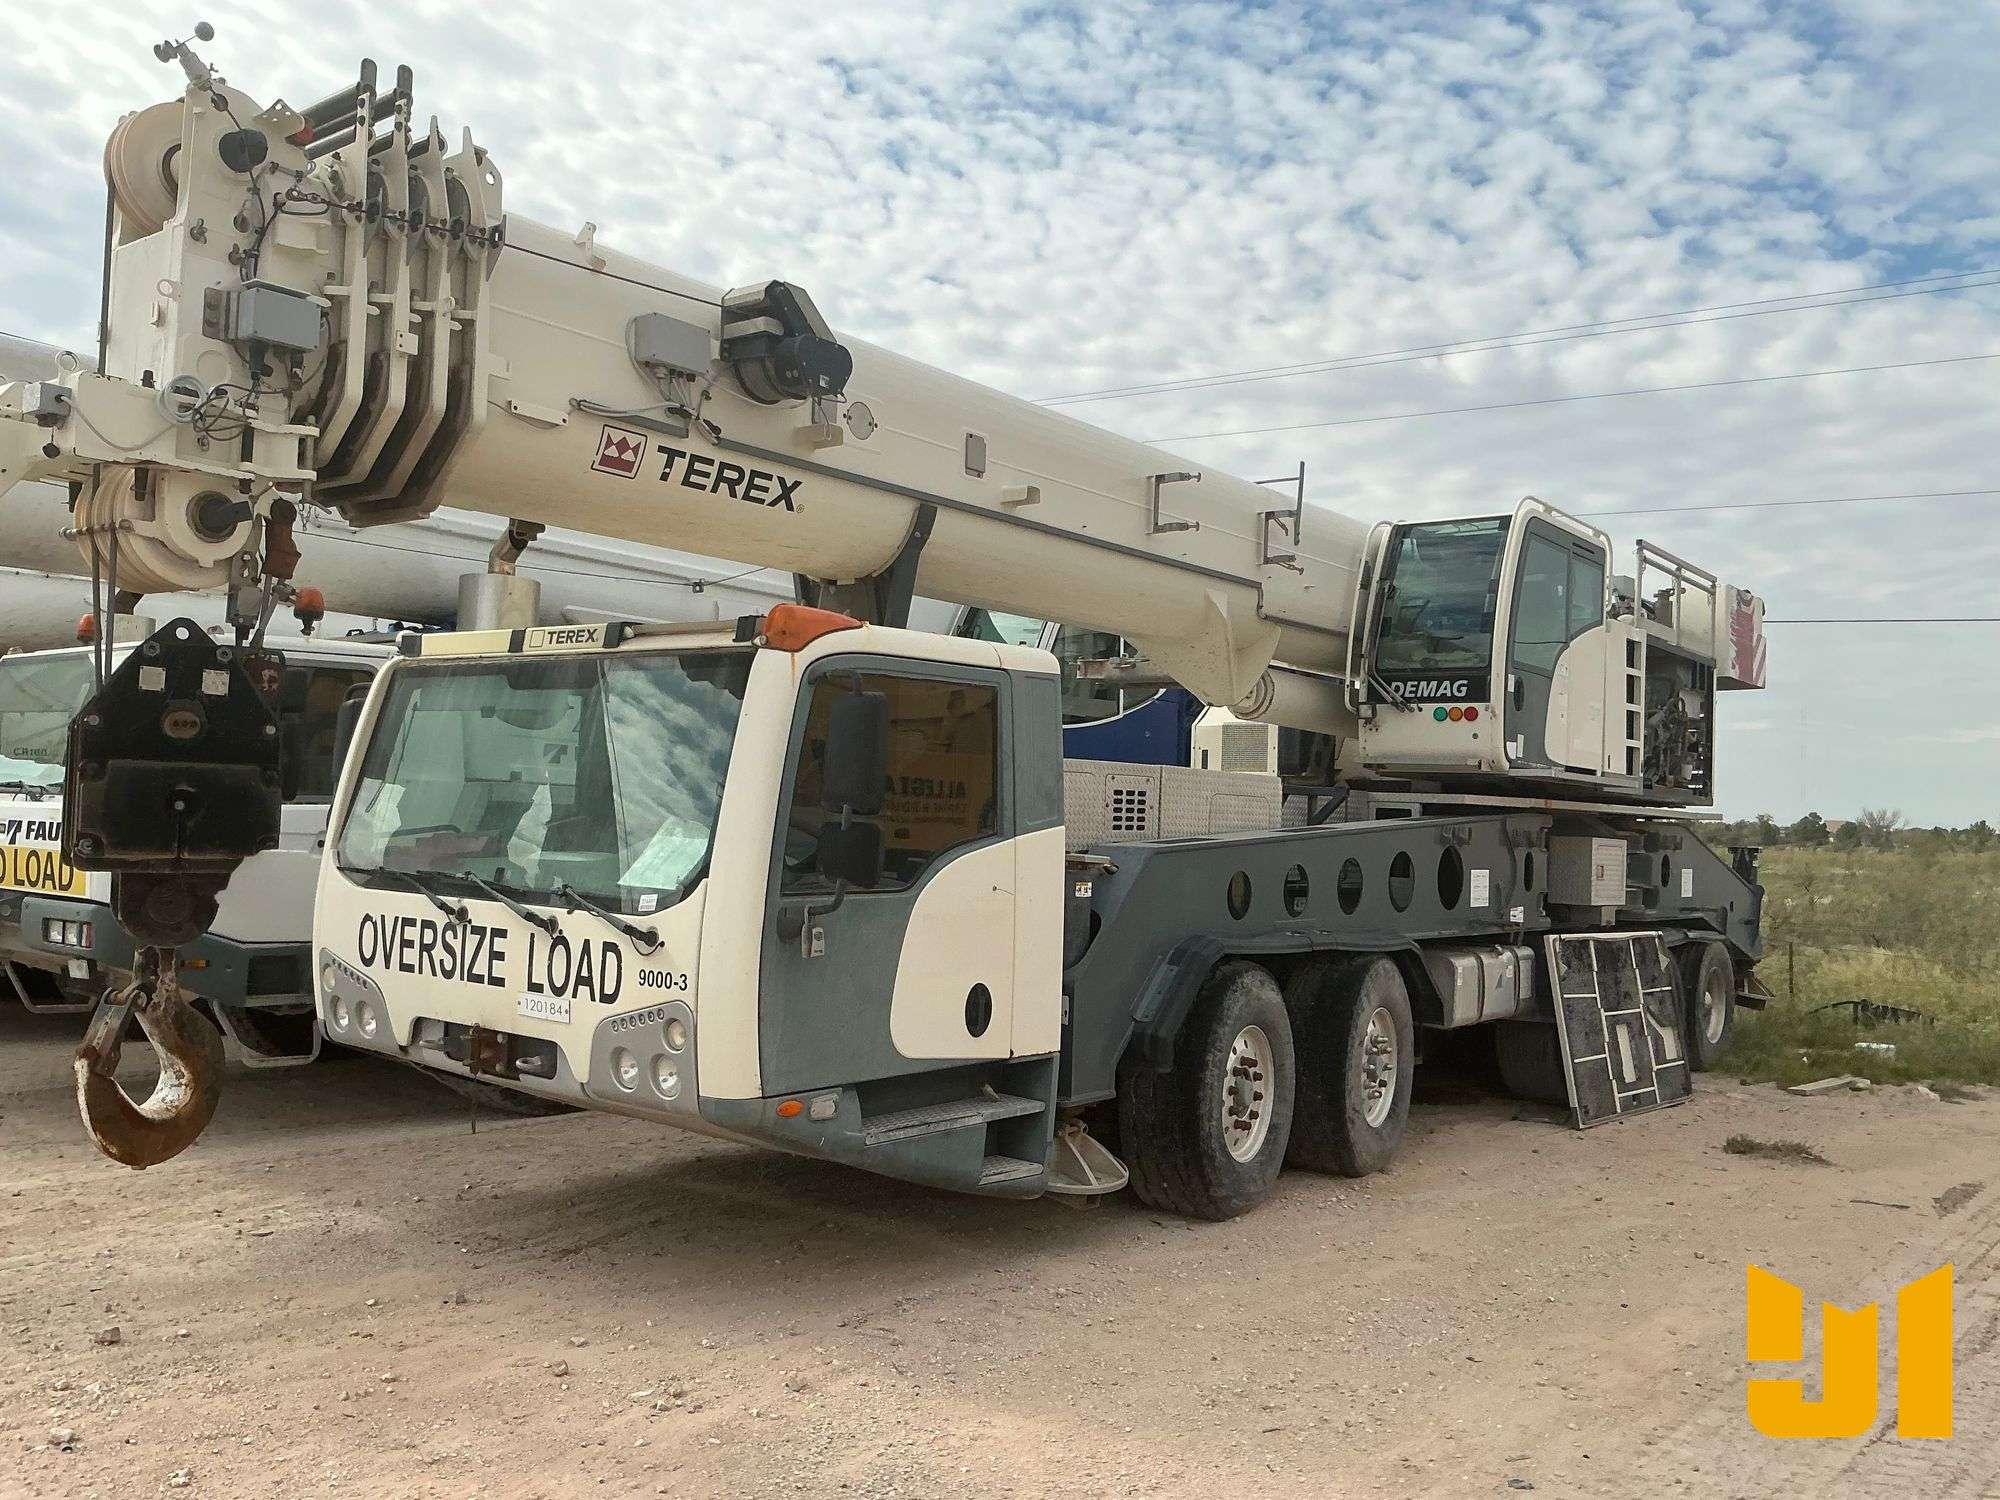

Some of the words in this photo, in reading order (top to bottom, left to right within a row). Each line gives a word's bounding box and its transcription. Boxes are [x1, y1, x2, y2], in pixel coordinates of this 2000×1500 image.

[656, 445, 802, 512] TEREX
[547, 628, 598, 645] TEREX
[1388, 680, 1469, 698] DEMAG
[25, 820, 62, 841] FAU
[13, 848, 75, 892] LOAD
[357, 912, 508, 988] OVERSIZE
[527, 932, 623, 1004] LOAD
[638, 968, 688, 991] 9000-3
[524, 998, 563, 1016] 120184
